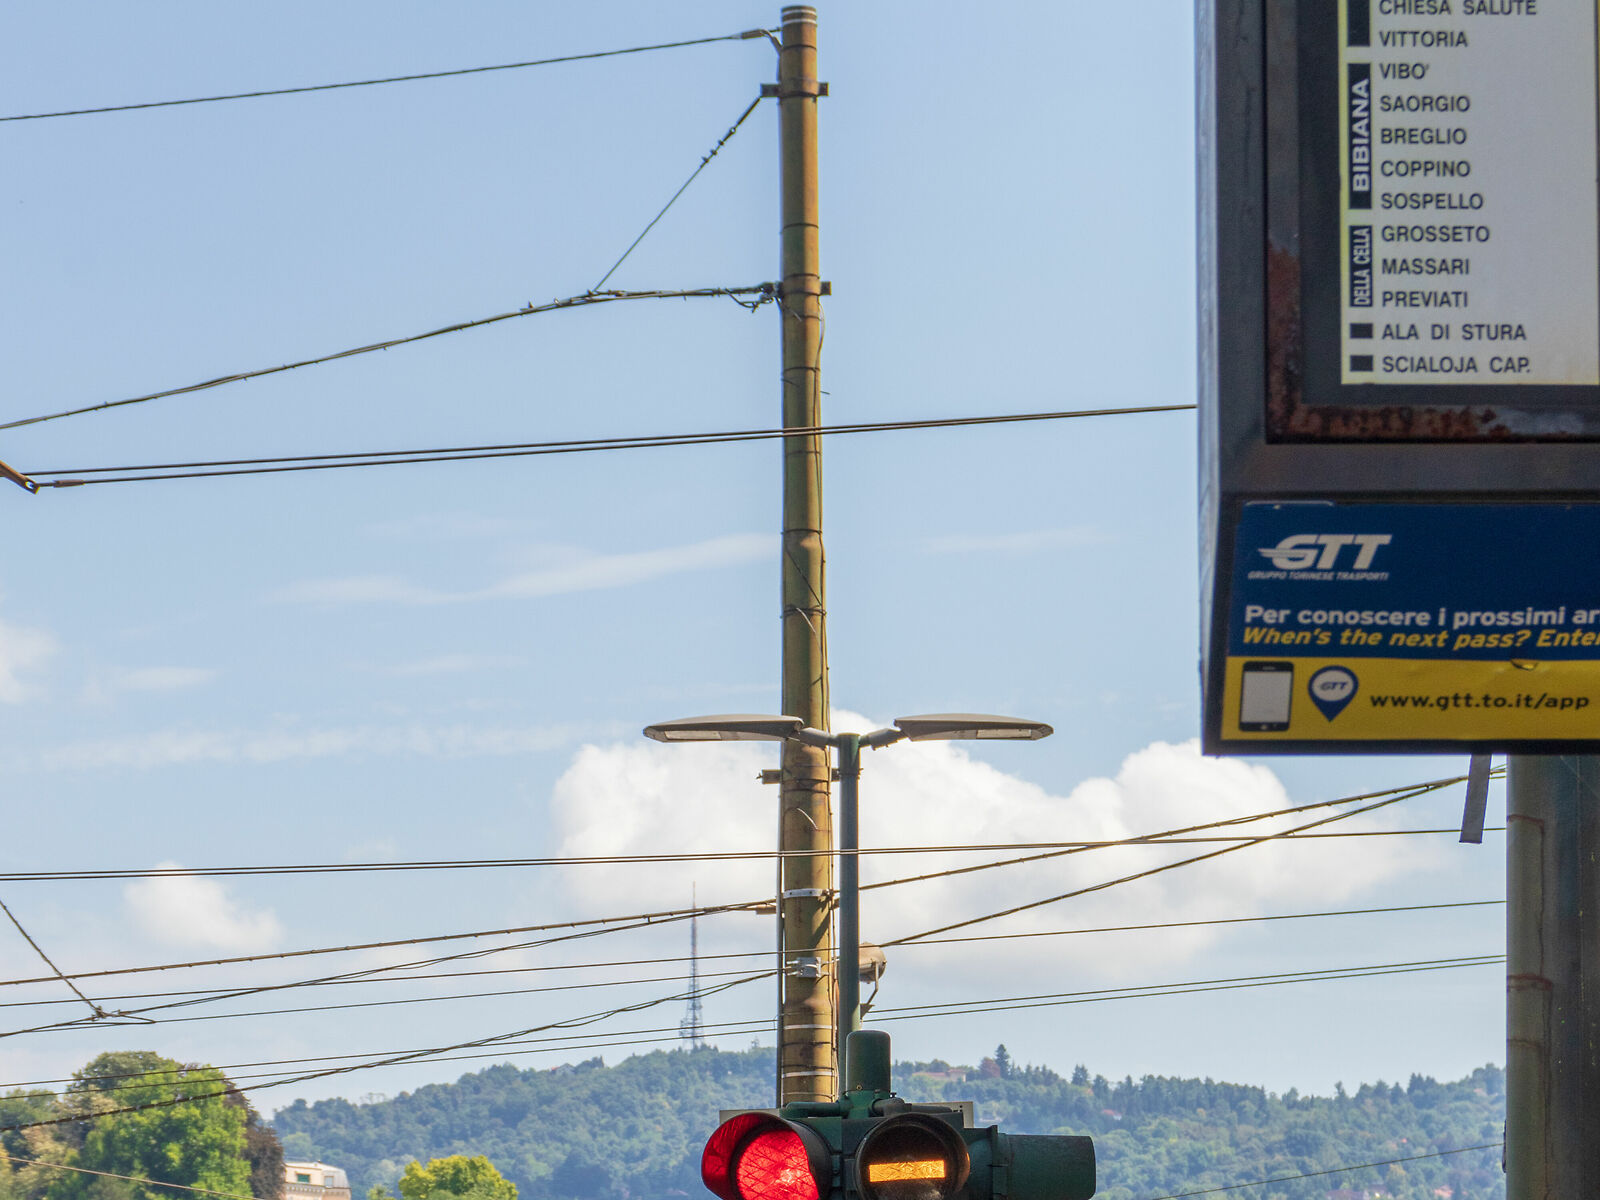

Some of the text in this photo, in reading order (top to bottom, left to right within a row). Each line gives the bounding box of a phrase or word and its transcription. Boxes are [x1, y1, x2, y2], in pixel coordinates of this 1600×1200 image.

[1379, 0, 1537, 15] CHIESA SALUTE
[1379, 31, 1468, 47] VITTORIA
[1379, 63, 1430, 80] VIBO'
[1380, 96, 1471, 112] SAORGIO
[1352, 78, 1370, 192] BIBIANA
[1381, 128, 1467, 145] BREGLIO
[1381, 161, 1471, 177] COPPINO
[1381, 193, 1484, 210] SOSPELLO
[1381, 226, 1490, 243] GROSSETO
[1353, 228, 1371, 306] DELLA CELLA
[1382, 259, 1469, 275] MASSARI
[1382, 291, 1468, 307] PREVIATI
[1382, 324, 1527, 340] ALA DI STURA
[1382, 357, 1531, 373] SCIALOJA CAP.
[1258, 534, 1393, 570] GTT
[1247, 571, 1389, 581] GRUPPO TORINESE TRASPORTI
[1244, 604, 1291, 624] Per
[1297, 608, 1431, 626] conoscere
[1438, 607, 1447, 626] i
[1452, 606, 1566, 630] prossimi
[1242, 626, 1332, 645] When's
[1340, 628, 1383, 646] the
[1388, 630, 1448, 648] next
[1452, 629, 1532, 651] pass?
[1318, 681, 1349, 691] GTT
[1370, 692, 1590, 711] www.gtt.to.it/app
